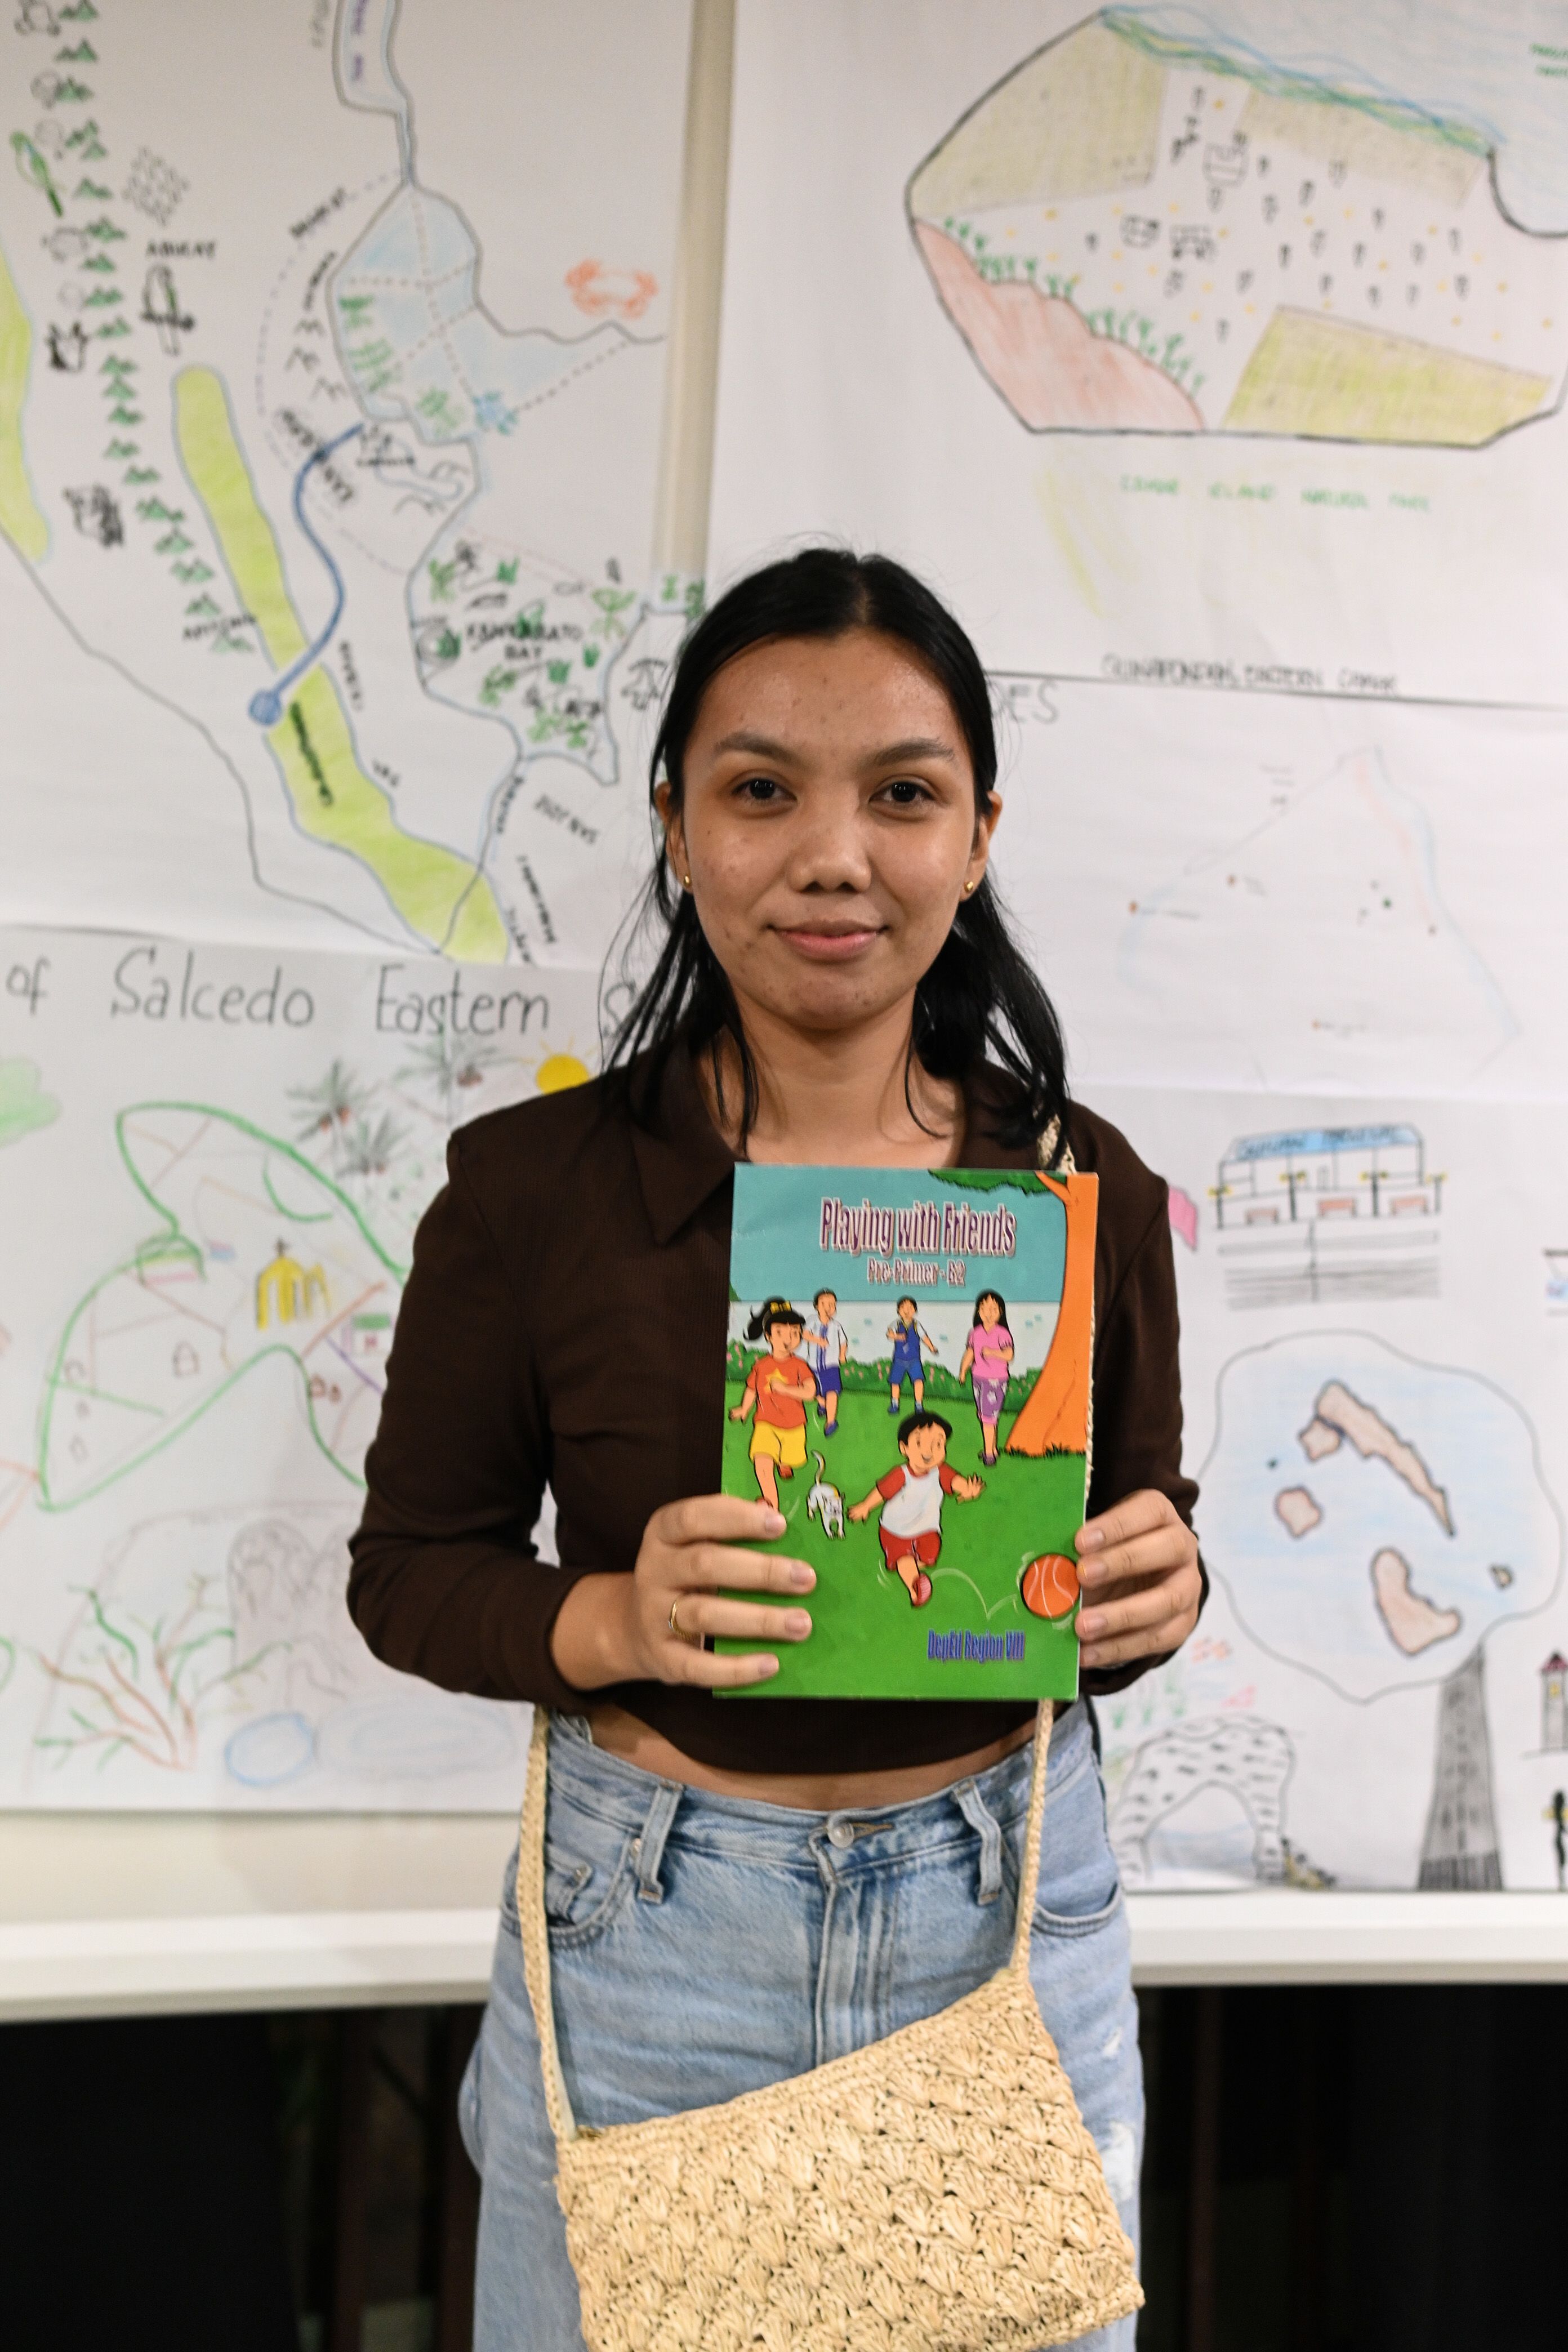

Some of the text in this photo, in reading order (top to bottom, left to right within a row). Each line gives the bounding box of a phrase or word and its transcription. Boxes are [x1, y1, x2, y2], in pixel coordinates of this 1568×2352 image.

[5, 955, 51, 1017] of
[111, 946, 315, 1027] Salcedo
[376, 963, 550, 1035] Eastern
[819, 1197, 1017, 1258] Playing with Friends
[867, 1257, 939, 1286] Pre-Primer
[927, 1628, 1026, 1664] DepEd Region VIII
